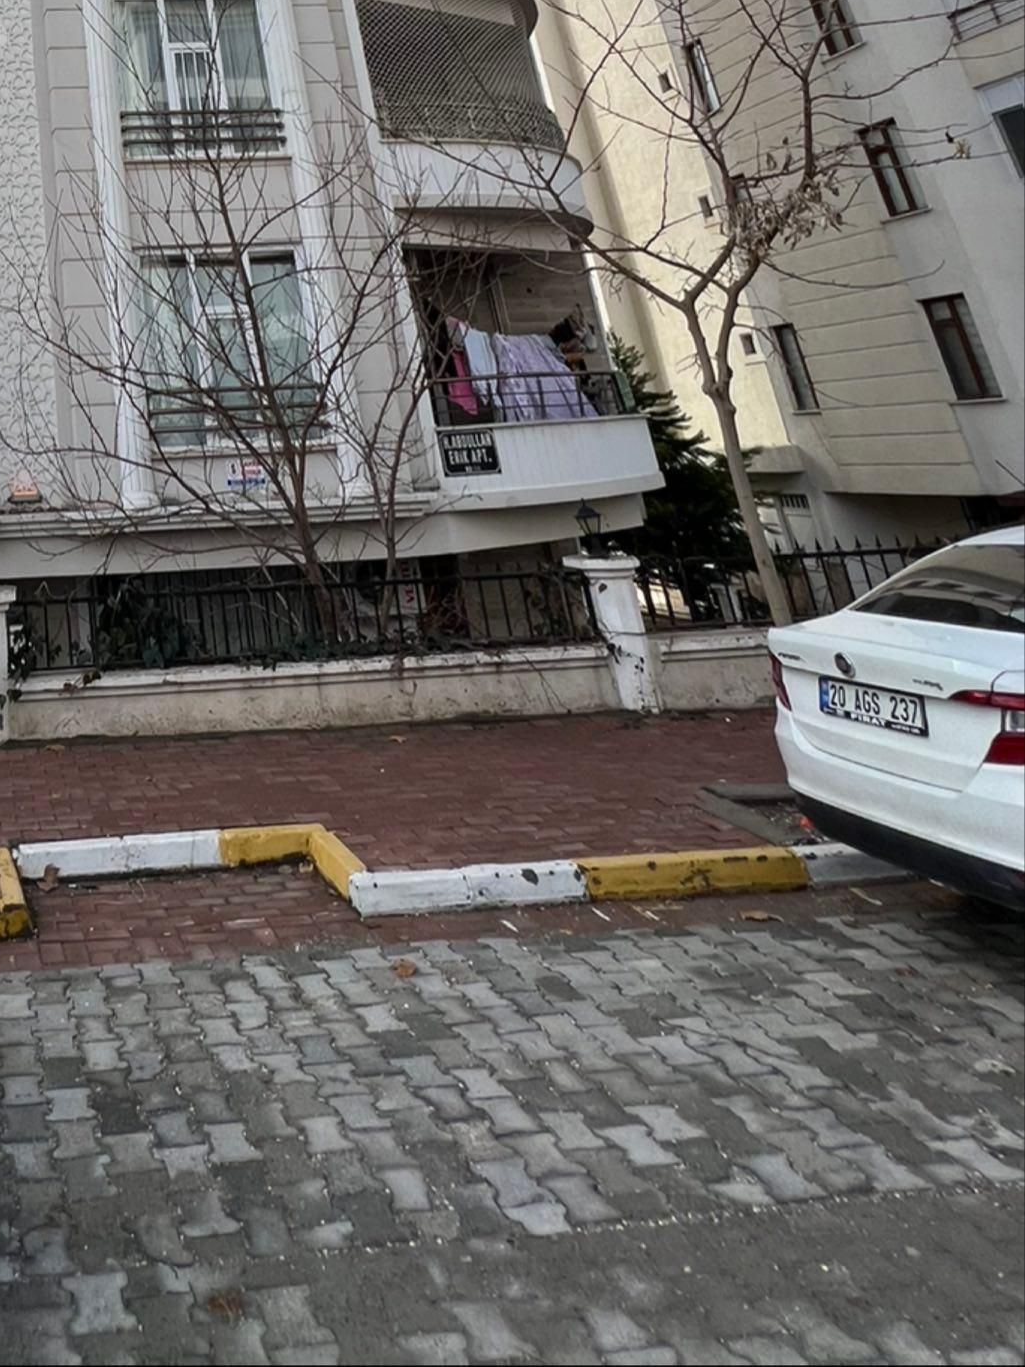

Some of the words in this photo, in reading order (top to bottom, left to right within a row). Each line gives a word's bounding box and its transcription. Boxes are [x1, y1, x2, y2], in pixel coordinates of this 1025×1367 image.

[829, 684, 846, 708] 20
[854, 689, 881, 715] AGS
[889, 696, 918, 724] 237
